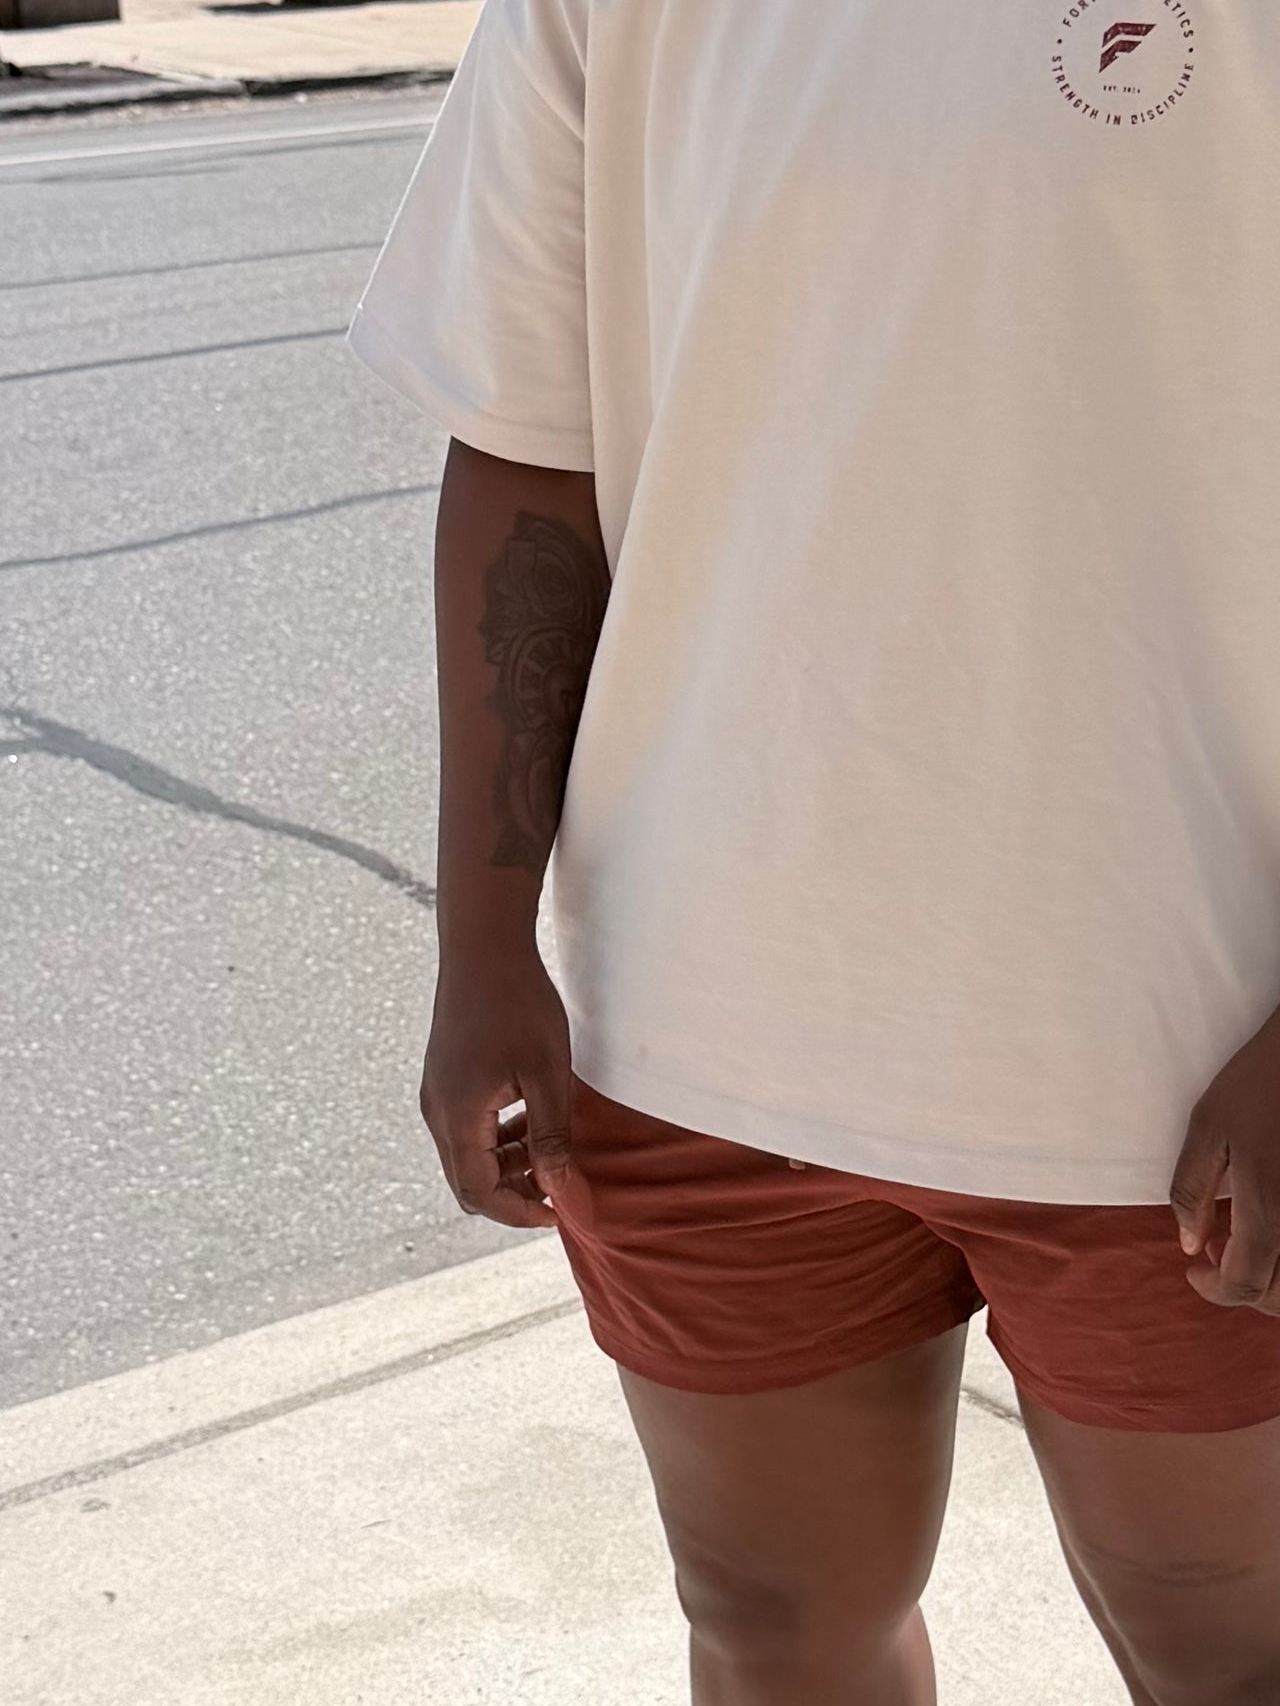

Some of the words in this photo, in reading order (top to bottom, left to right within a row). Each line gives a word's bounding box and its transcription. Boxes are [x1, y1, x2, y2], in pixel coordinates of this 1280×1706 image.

[1052, 55, 1099, 120] STRENGTH
[1106, 114, 1121, 126] IN
[1131, 63, 1194, 125] DISCIPLINE
